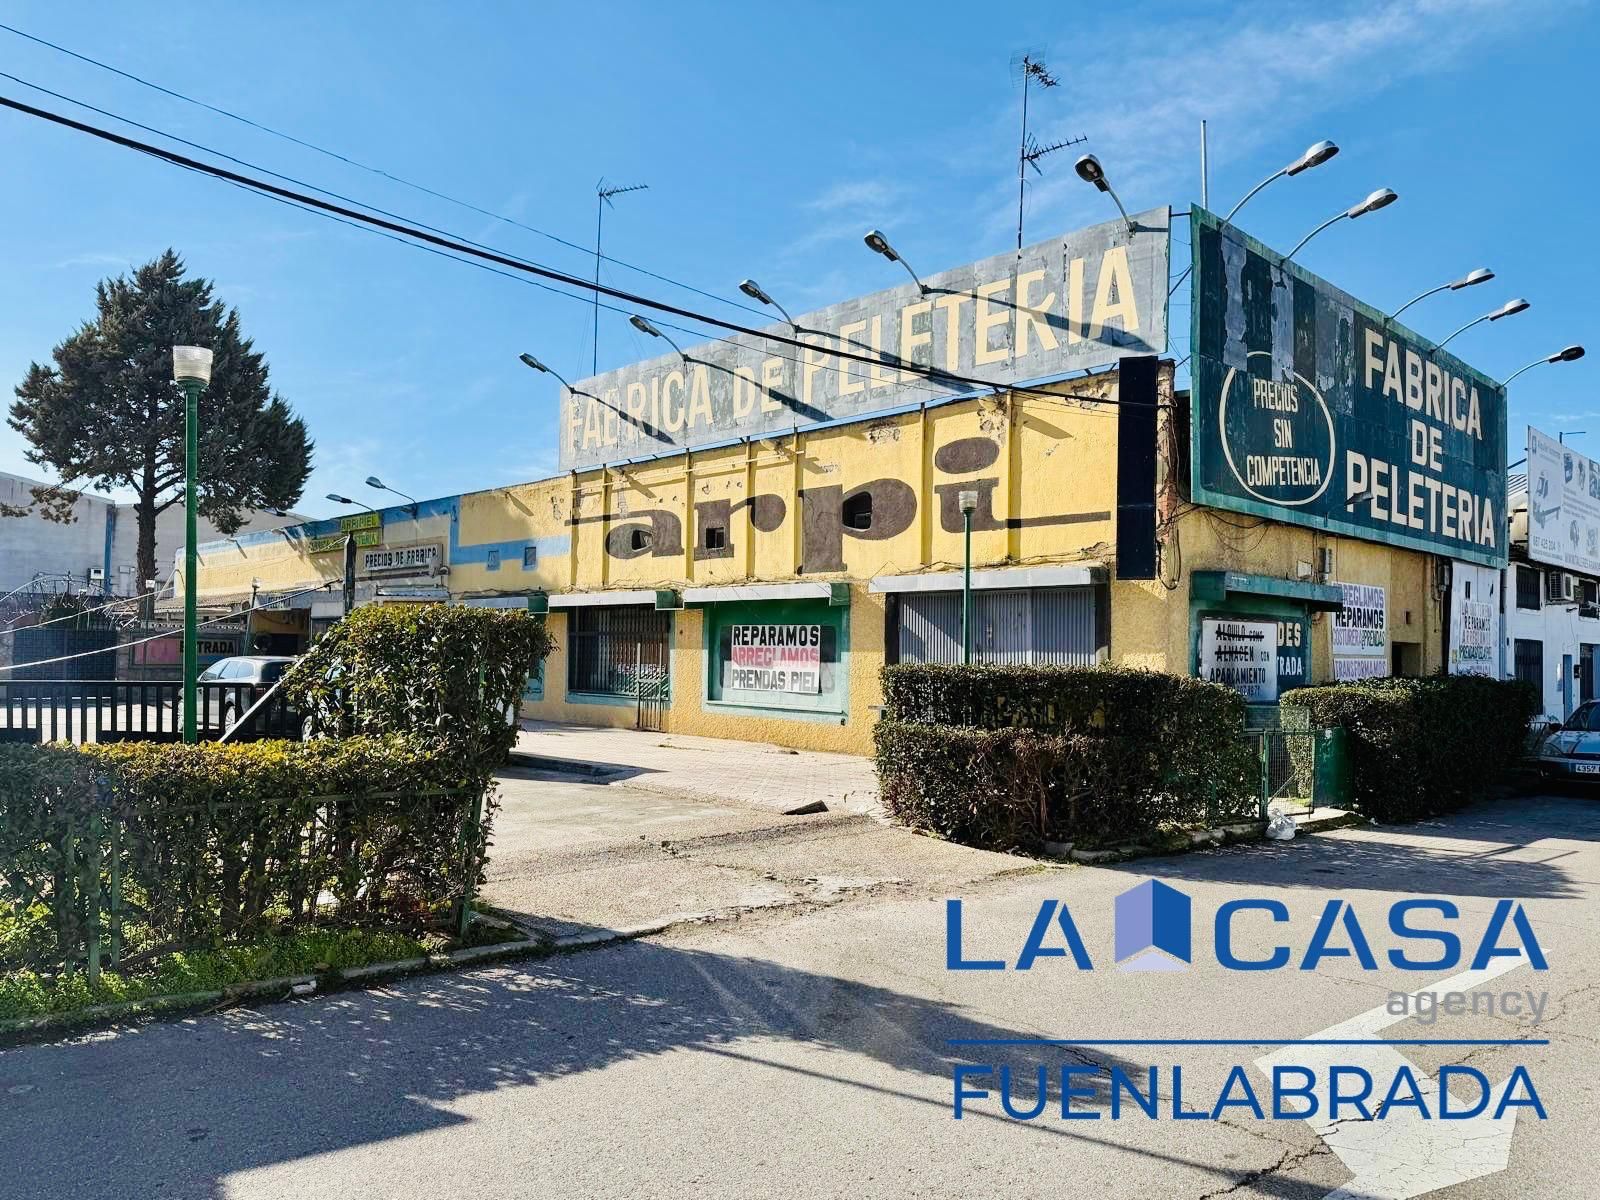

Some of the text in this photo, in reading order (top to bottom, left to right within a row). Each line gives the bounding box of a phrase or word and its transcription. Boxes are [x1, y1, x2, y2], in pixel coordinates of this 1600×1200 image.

[733, 358, 785, 419] DE
[803, 245, 1140, 401] PELETERIA
[1253, 377, 1299, 413] PRECIOS
[1365, 327, 1483, 441] FABRICA
[1273, 418, 1293, 449] SIN
[1411, 418, 1443, 473] DE
[1246, 454, 1322, 487] COMPETENCIA
[1346, 449, 1496, 549] PELETERIA
[365, 552, 392, 568] PRECIOS
[1342, 584, 1384, 609] REGLAMOS
[1336, 607, 1384, 629] REPARAMOS
[179, 640, 235, 655] ETRADA
[733, 625, 820, 647] REPARAMOS
[731, 646, 819, 669] ARREGLAMOS
[731, 669, 819, 692] PRENDAS PIEL
[1210, 667, 1266, 685] APARCAMIENTO
